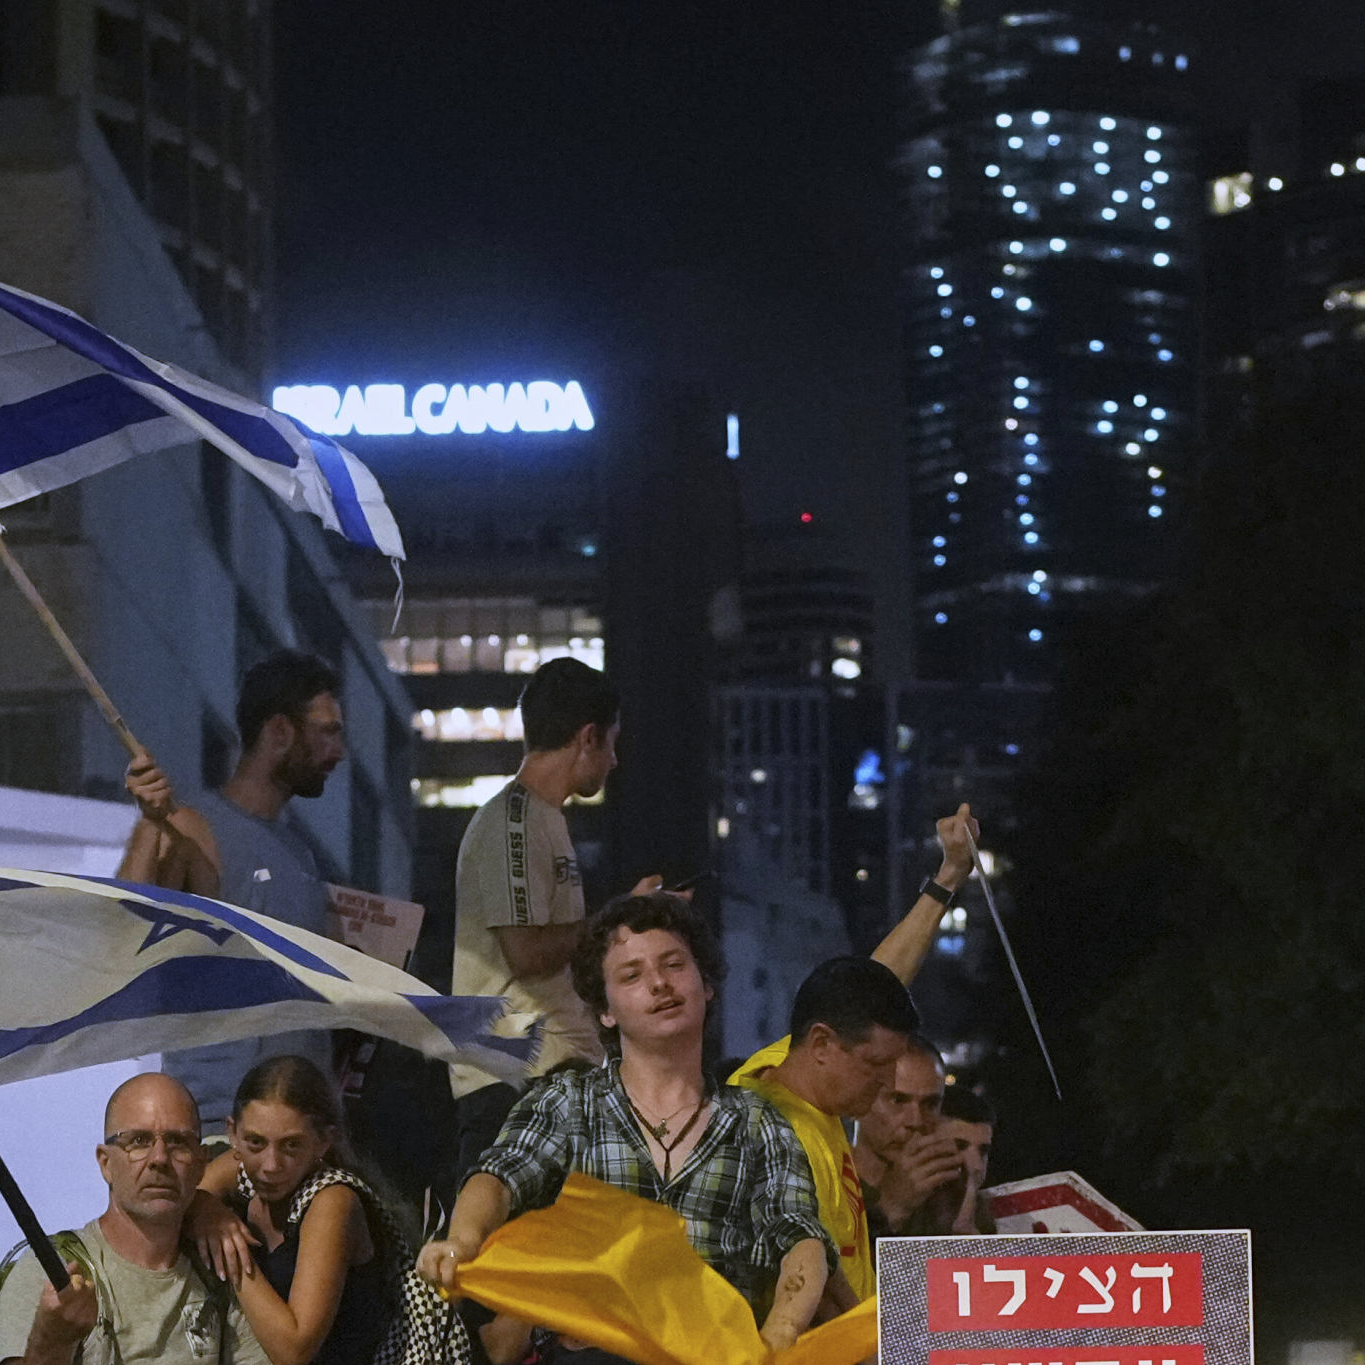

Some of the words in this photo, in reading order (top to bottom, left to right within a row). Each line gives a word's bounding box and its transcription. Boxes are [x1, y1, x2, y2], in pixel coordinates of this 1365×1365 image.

[412, 380, 595, 434] CANADA
[510, 832, 524, 879] GUESS
[514, 887, 528, 925] UESS
[952, 1262, 1174, 1317] הצילו
